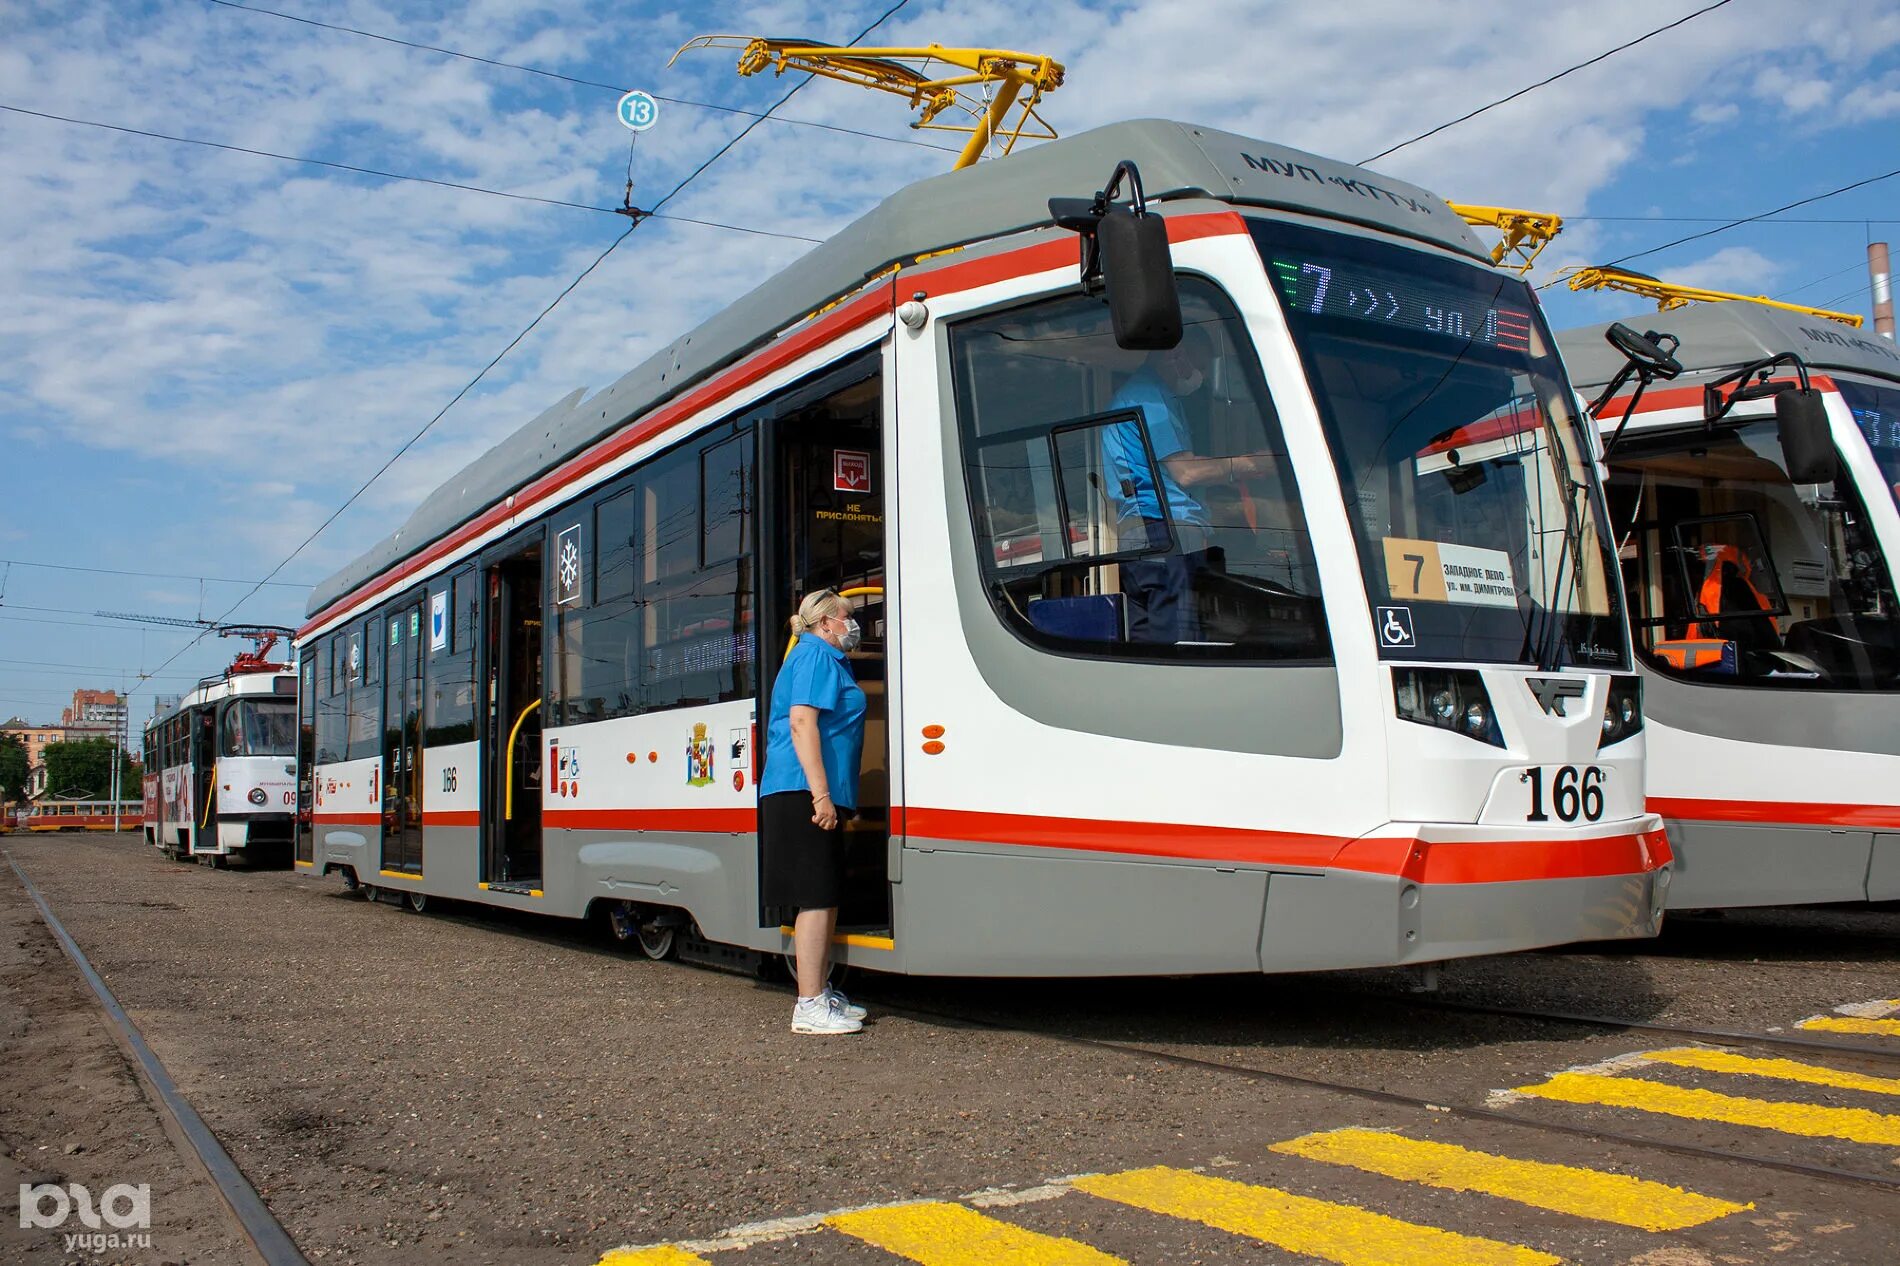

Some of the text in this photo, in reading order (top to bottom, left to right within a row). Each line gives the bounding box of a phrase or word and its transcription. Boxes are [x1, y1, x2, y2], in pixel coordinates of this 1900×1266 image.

[627, 100, 650, 122] 13
[1240, 152, 1325, 185] МУП
[1302, 262, 1332, 314] 7
[816, 511, 884, 523] ПРИСЛОНЯТЬС
[847, 504, 861, 513] НЕ
[1403, 554, 1425, 594] 7
[1443, 564, 1484, 579] ЗАПАДНОЕ
[1485, 570, 1505, 581] ДЕПО
[1460, 583, 1473, 592] им.
[1474, 583, 1515, 597] ДИМИТРОВА
[443, 767, 457, 793] 166
[1526, 765, 1604, 822] 166
